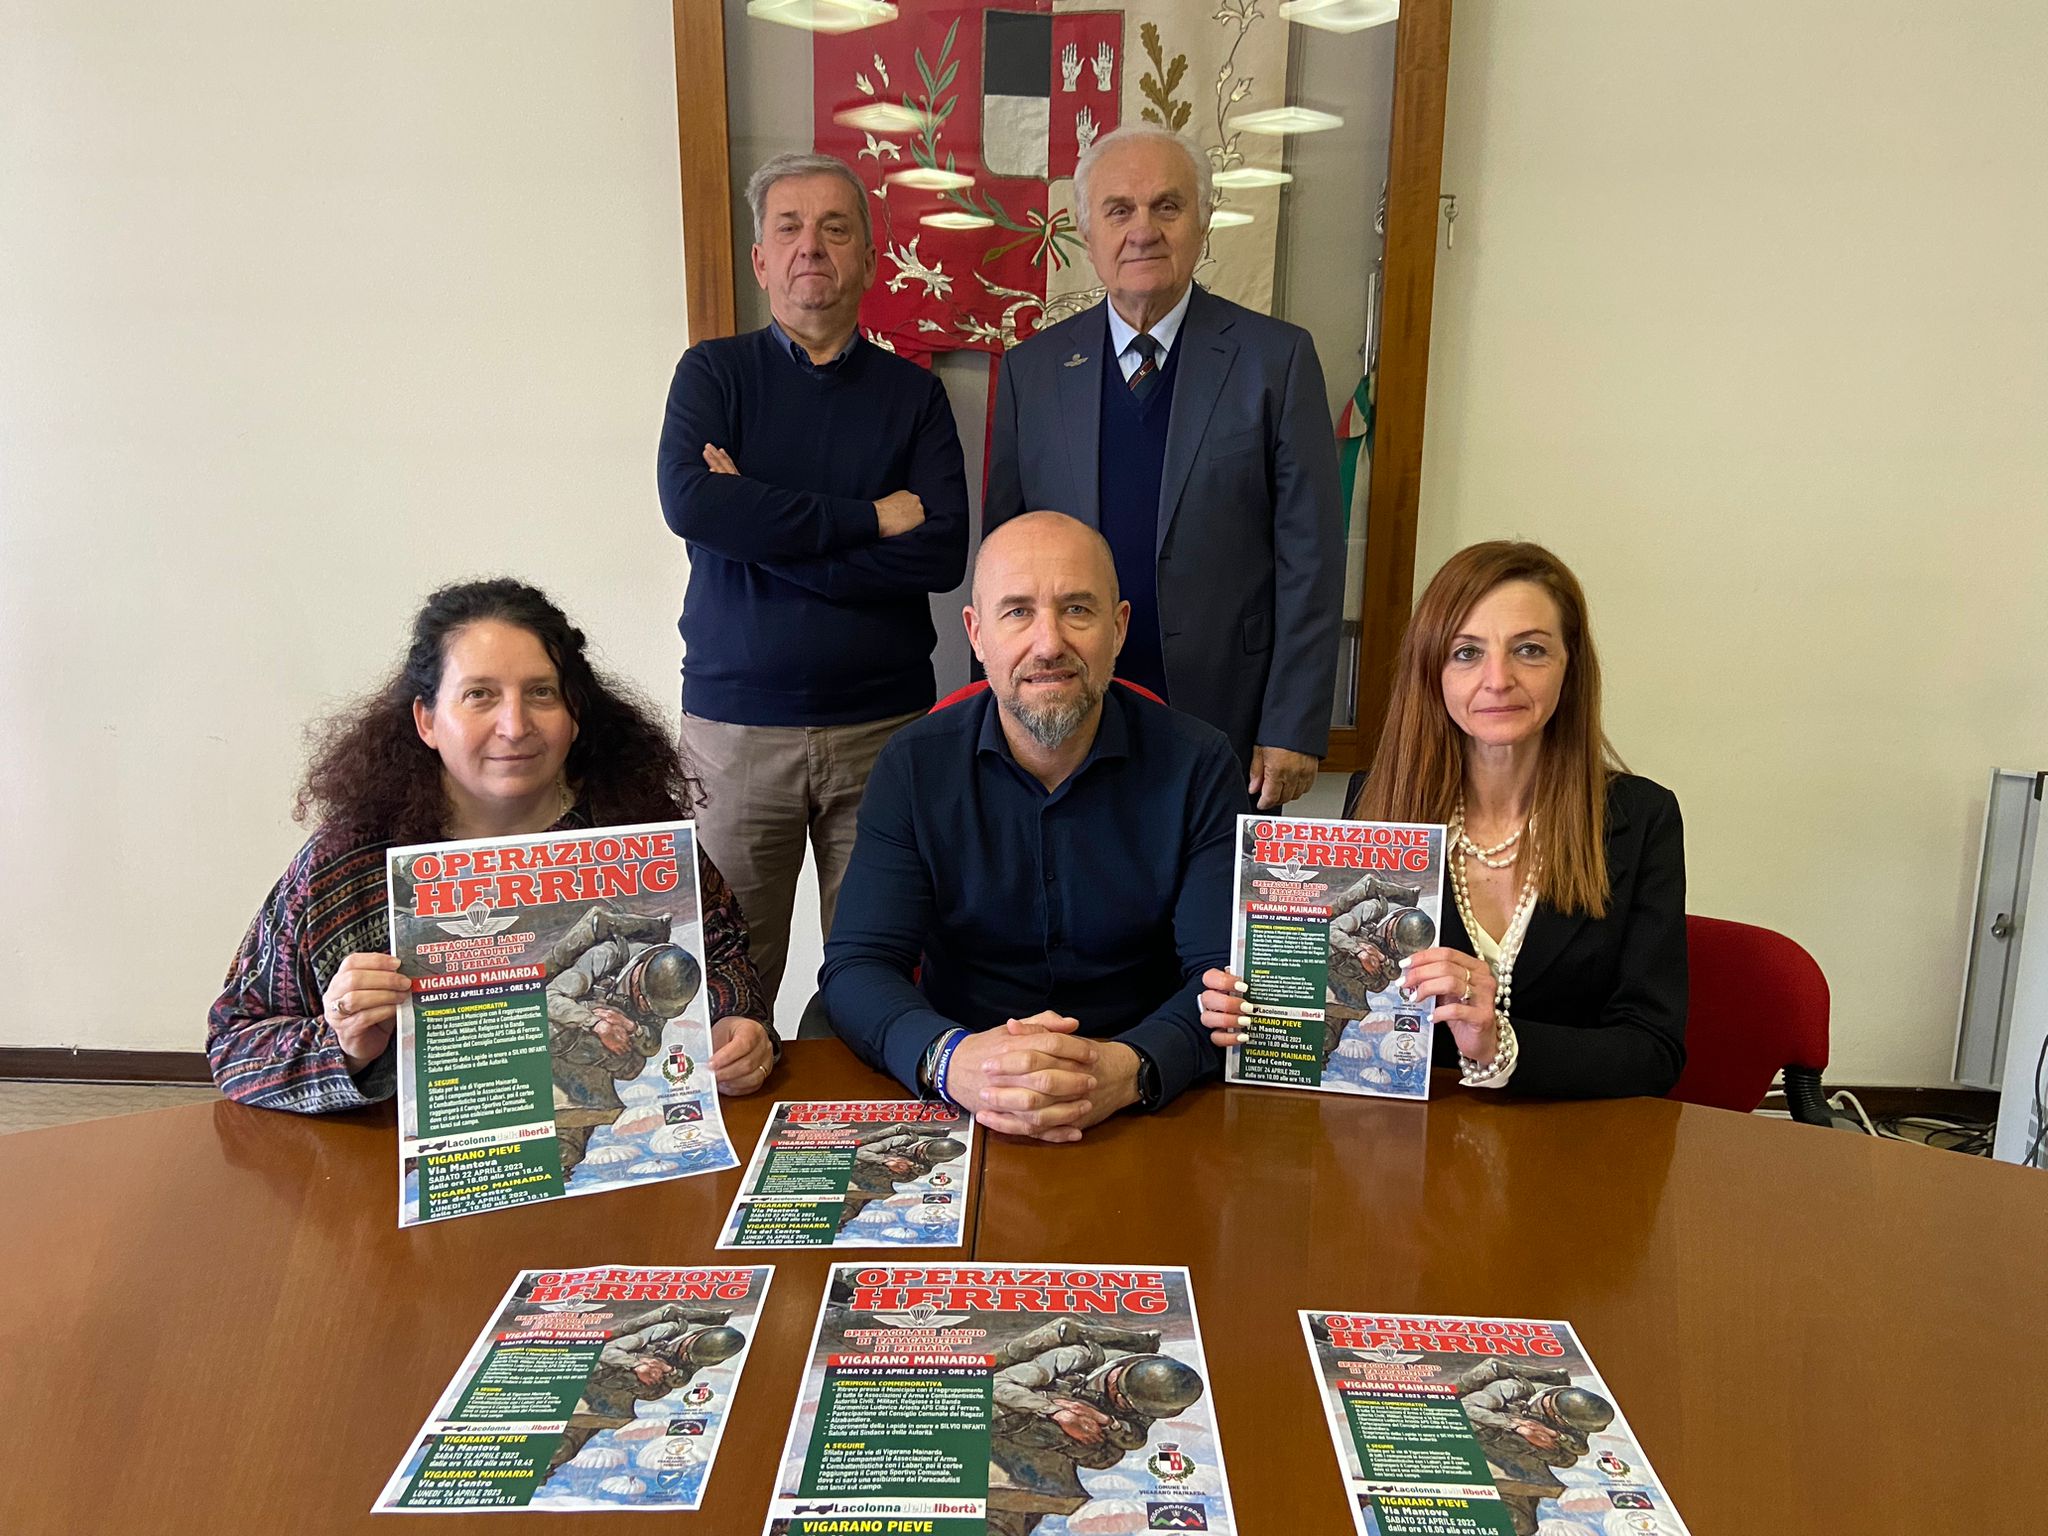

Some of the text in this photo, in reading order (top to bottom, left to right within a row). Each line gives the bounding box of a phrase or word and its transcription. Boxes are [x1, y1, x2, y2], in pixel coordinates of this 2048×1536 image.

[1254, 821, 1430, 846] OPERAZIONE
[412, 833, 674, 880] OPERAZIONE
[1254, 841, 1429, 871] HERRING
[414, 858, 677, 917] HERRING
[1251, 903, 1327, 915] VIGARANO MAINARDA
[417, 931, 535, 955] SPETTACOLARE LANCIO
[429, 944, 524, 964] DI PARACADUTISTI
[446, 956, 509, 972] DI FERRARA
[419, 966, 539, 990] VIGARANO MAINARDA
[421, 981, 541, 1002] SABATO 22 APRILE 2023 ORE 9,30
[1249, 1016, 1301, 1028] IGARANO PIEVE
[1259, 1025, 1286, 1034] Mantova
[1245, 1048, 1315, 1061] VIGARANO MAINARDA
[938, 1048, 951, 1076] VINCE
[1270, 1058, 1291, 1066] Centro
[786, 1111, 959, 1122] HERRING
[427, 1145, 520, 1165] VIGARANO PIEVE
[427, 1159, 497, 1176] Via Mantova
[428, 1174, 460, 1183] SABATO
[473, 1167, 502, 1175] APRILE
[503, 1162, 523, 1171] 2023
[429, 1182, 448, 1191] dalle
[429, 1174, 552, 1199] VIGARANO MAINARDA
[429, 1188, 512, 1206] Via del Centro
[476, 1195, 506, 1204] APRILE
[508, 1190, 528, 1198] 2023
[537, 1270, 753, 1285] OPERAZIONE
[855, 1268, 1164, 1288] OPERAZIONE
[527, 1283, 749, 1301] HERRING
[849, 1287, 1169, 1313] HERRING
[844, 1328, 987, 1337] SPETTACOLARE LANCIO
[1325, 1315, 1554, 1337] OPERAZIONE
[875, 1337, 972, 1345] PARACADUTISTI
[893, 1344, 952, 1352] FERRARA
[1330, 1331, 1565, 1356] HERRING
[838, 1355, 986, 1365] VIGARANO MAINARDA
[1343, 1381, 1452, 1392] VIGARANO MAINARDA
[442, 1435, 496, 1443] VIGARANO
[422, 1469, 535, 1478] VIGARANO MAINARDA
[417, 1479, 437, 1487] Via
[436, 1479, 456, 1487] del
[481, 1488, 502, 1496] 2023
[1377, 1496, 1469, 1508] VIGARANO PIEVE
[1381, 1506, 1449, 1516] Via Mantova
[801, 1520, 933, 1532] VIGARANO PIEVE
[1384, 1515, 1477, 1526] SABATO 22 APRILE 2023
